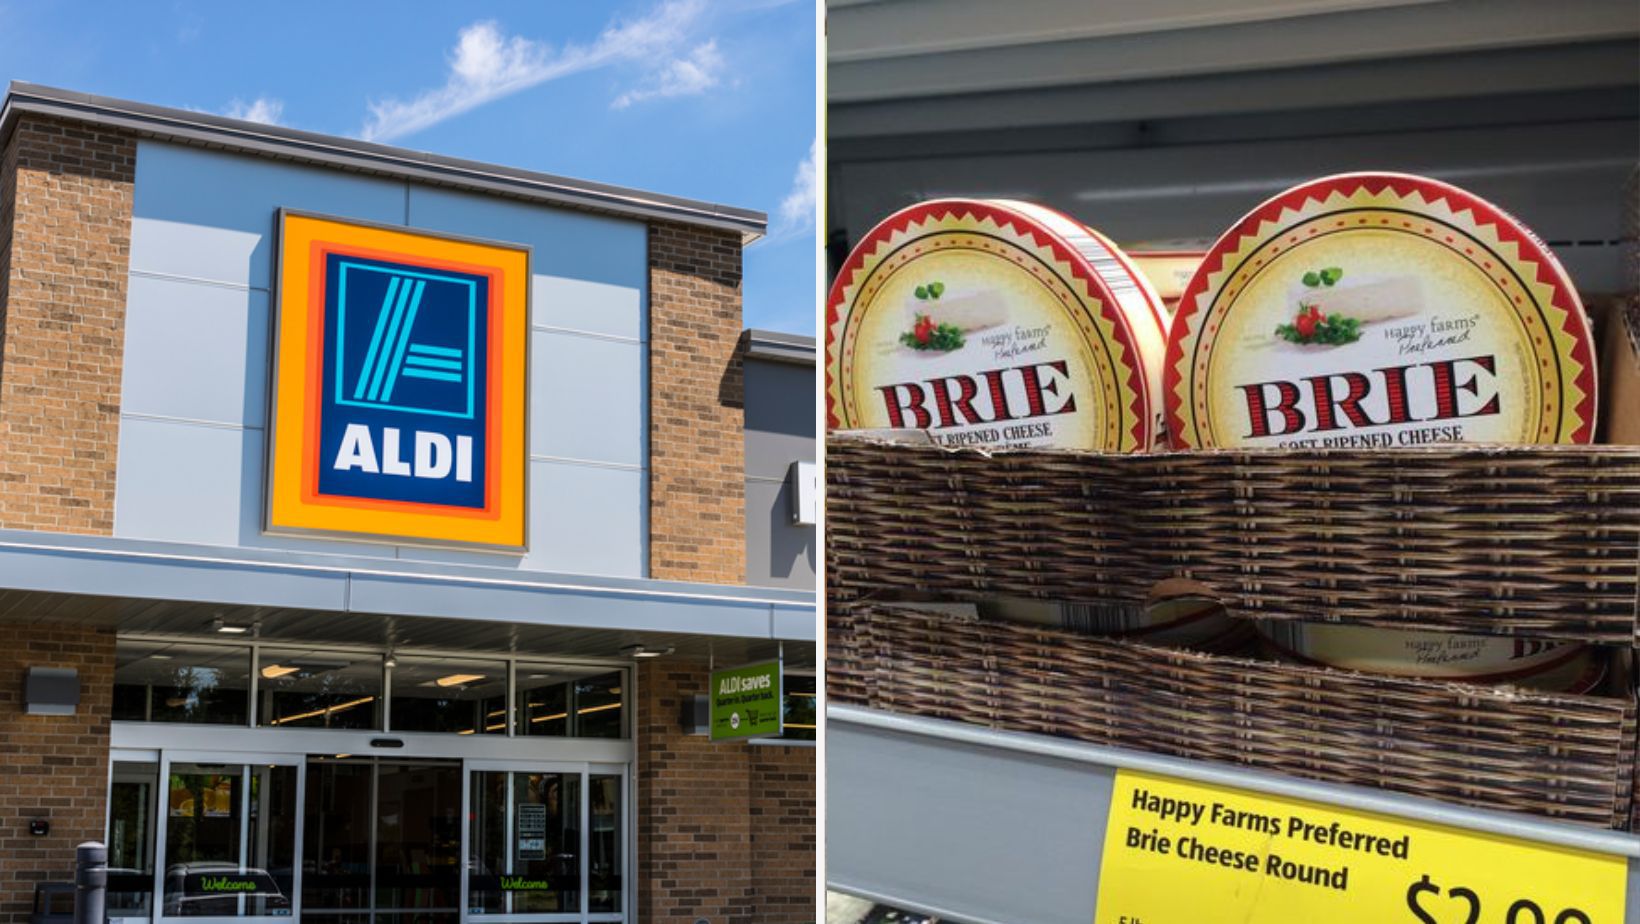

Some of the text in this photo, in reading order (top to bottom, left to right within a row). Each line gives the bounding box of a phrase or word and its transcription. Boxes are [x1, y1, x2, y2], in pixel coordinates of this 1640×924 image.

[874, 360, 1077, 430] BRIE
[1234, 354, 1500, 439] BRIE
[333, 423, 473, 482] ALDI
[946, 428, 1000, 445] RIPENED
[1004, 422, 1053, 440] CHEESE
[1323, 432, 1393, 450] RIPENED
[1398, 425, 1464, 445] CHEESE
[1131, 788, 1409, 860] Happy Farms Preferred
[201, 876, 257, 892] Welcome
[500, 876, 549, 890] Welcome
[1126, 826, 1348, 890] Brie Cheese Round
